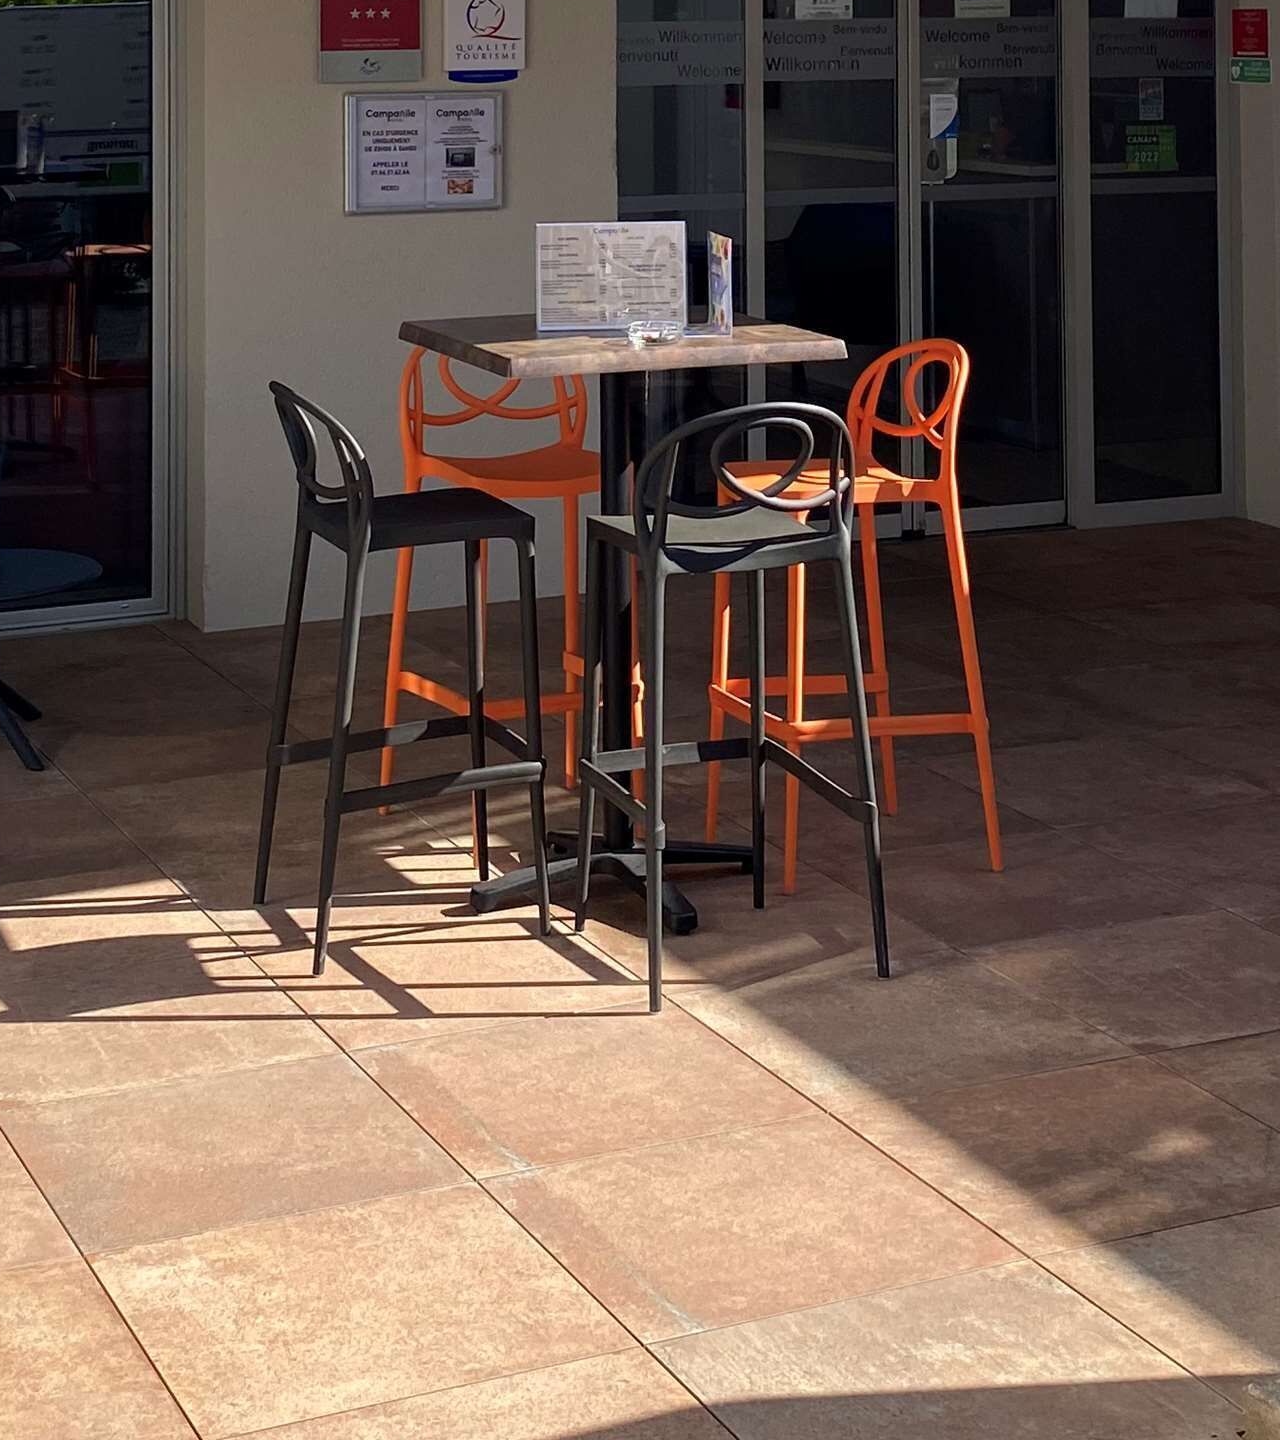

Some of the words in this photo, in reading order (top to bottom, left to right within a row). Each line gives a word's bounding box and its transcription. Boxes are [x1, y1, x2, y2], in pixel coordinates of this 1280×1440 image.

[658, 30, 742, 43] Willkommen
[926, 29, 991, 42] Welcome
[618, 50, 679, 63] envenuti
[677, 64, 742, 78] Welcome
[1156, 58, 1213, 71] Welcome
[592, 227, 629, 237] Campale
